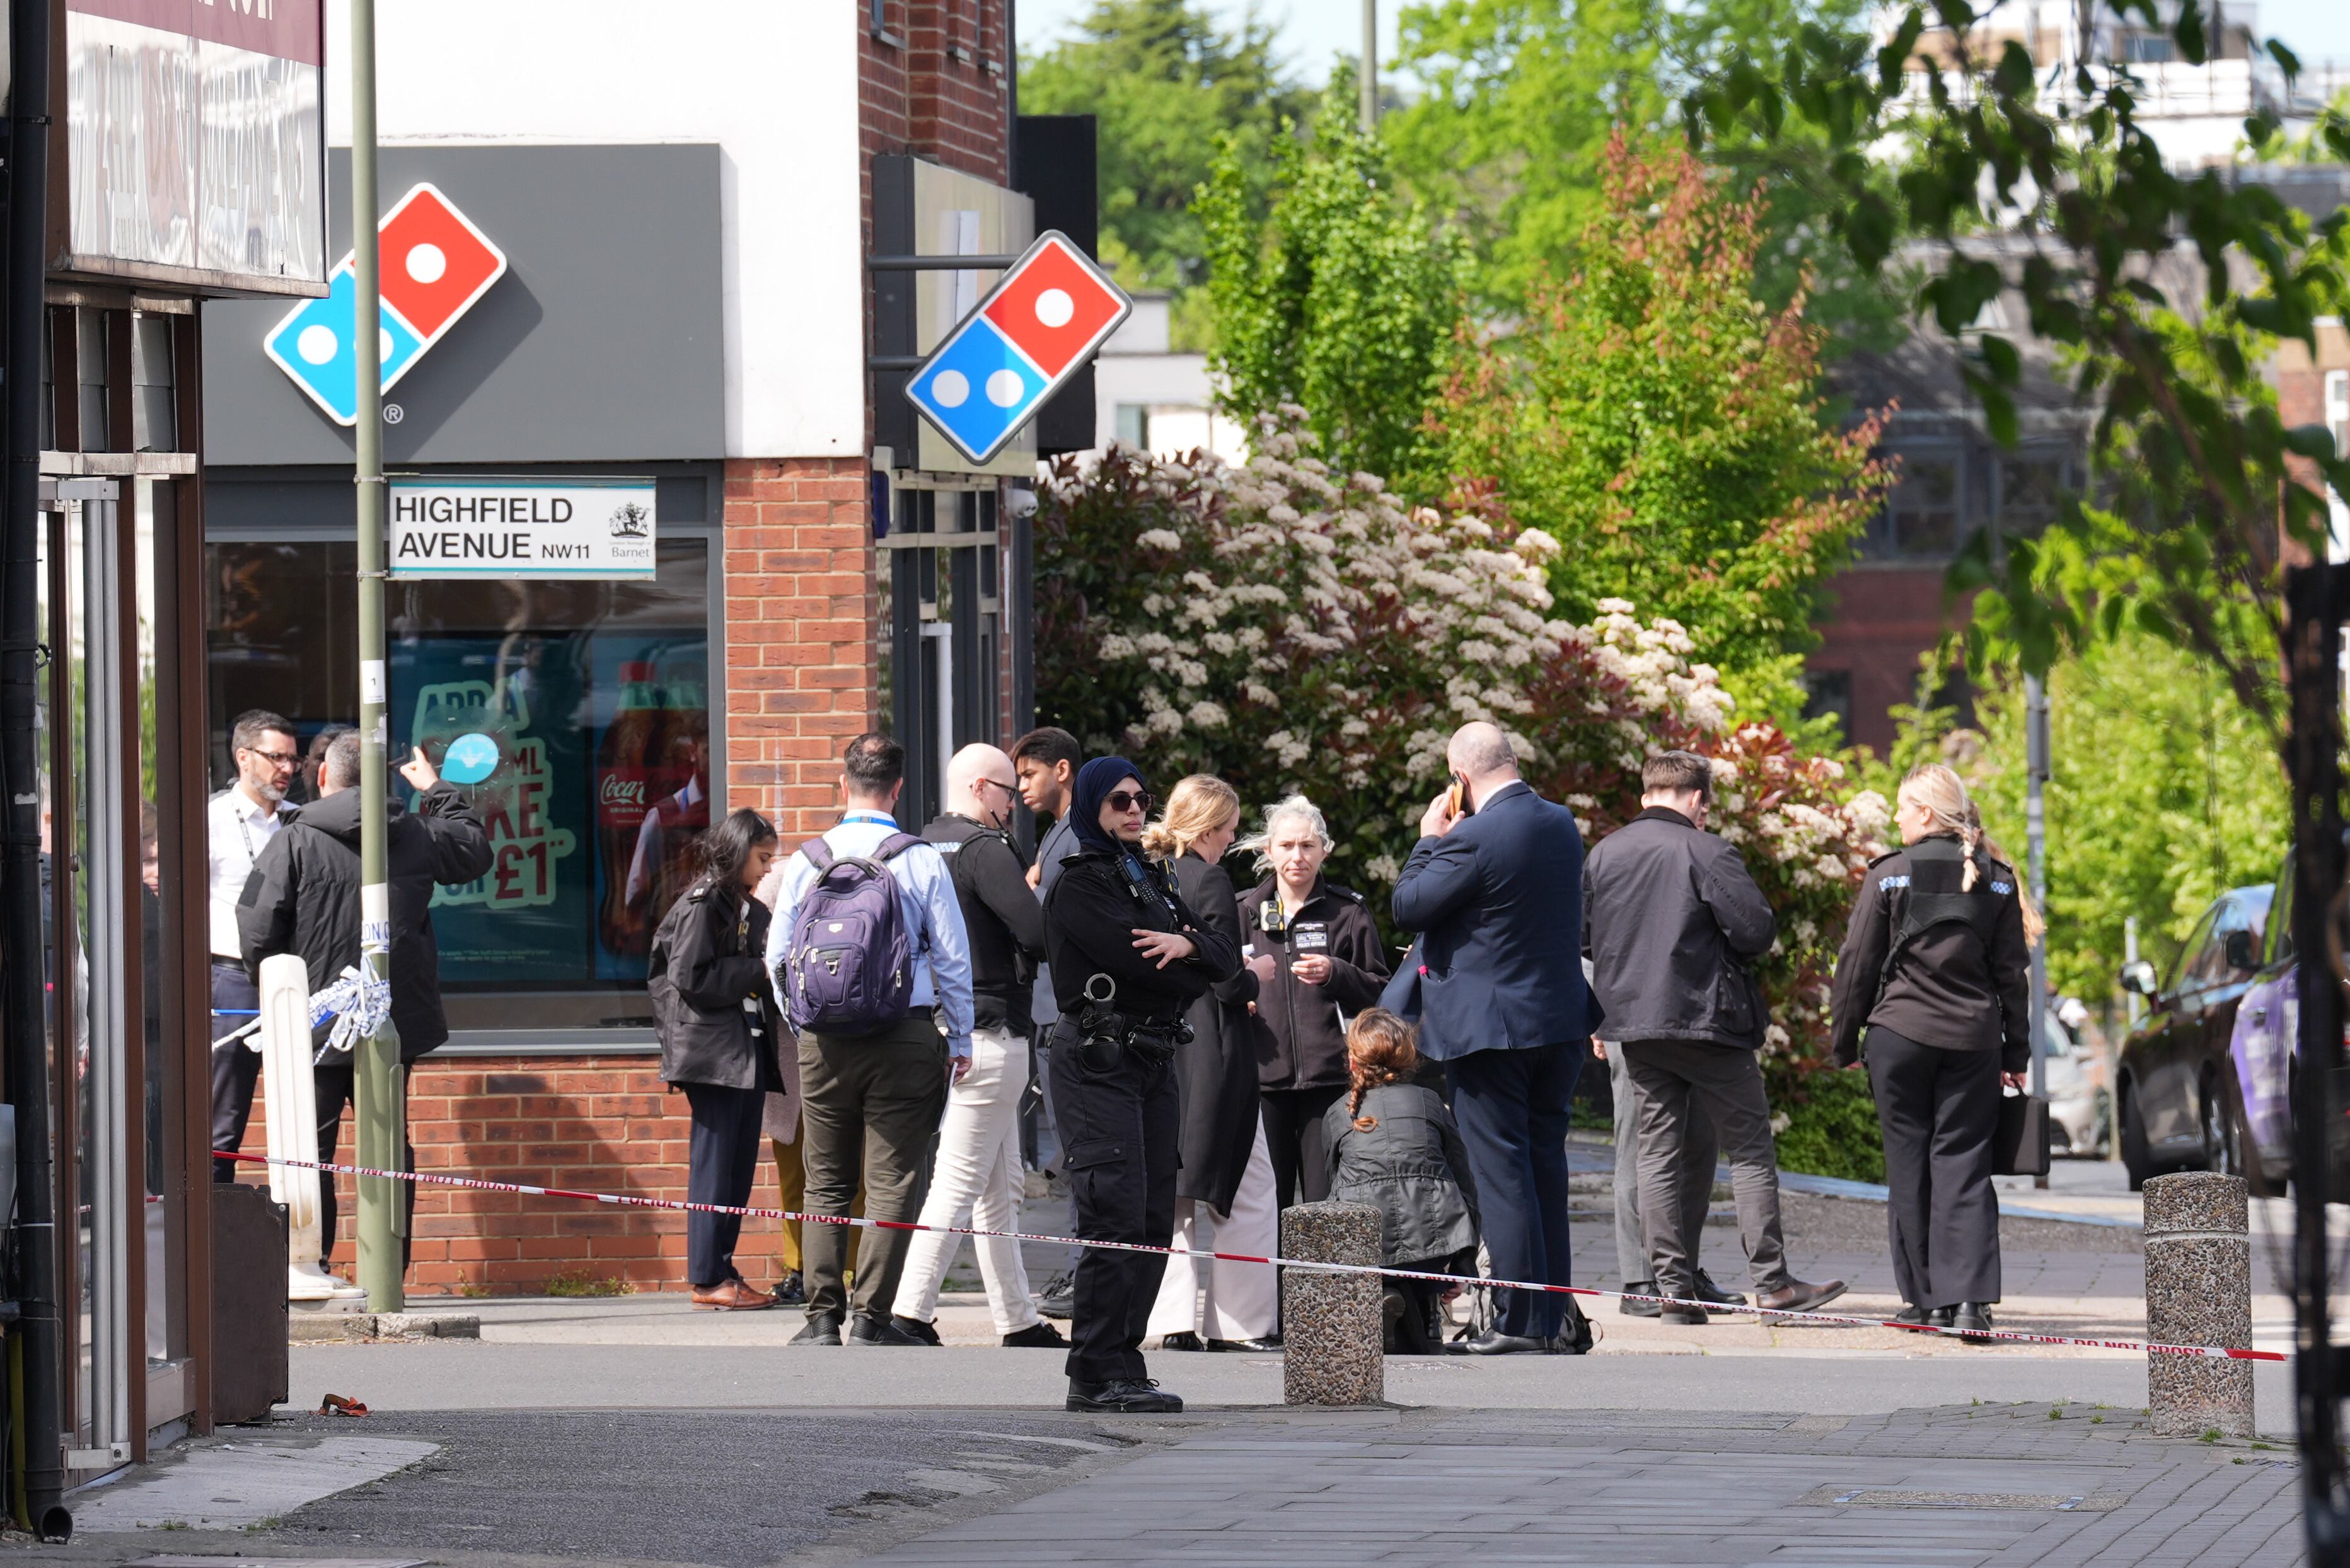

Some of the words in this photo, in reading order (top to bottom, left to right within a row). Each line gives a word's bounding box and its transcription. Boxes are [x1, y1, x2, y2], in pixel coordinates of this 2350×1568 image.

[396, 497, 573, 523] HIGHFIELD
[398, 533, 531, 559] AVENUE
[542, 544, 590, 559] NW11
[611, 546, 650, 558] Barnet
